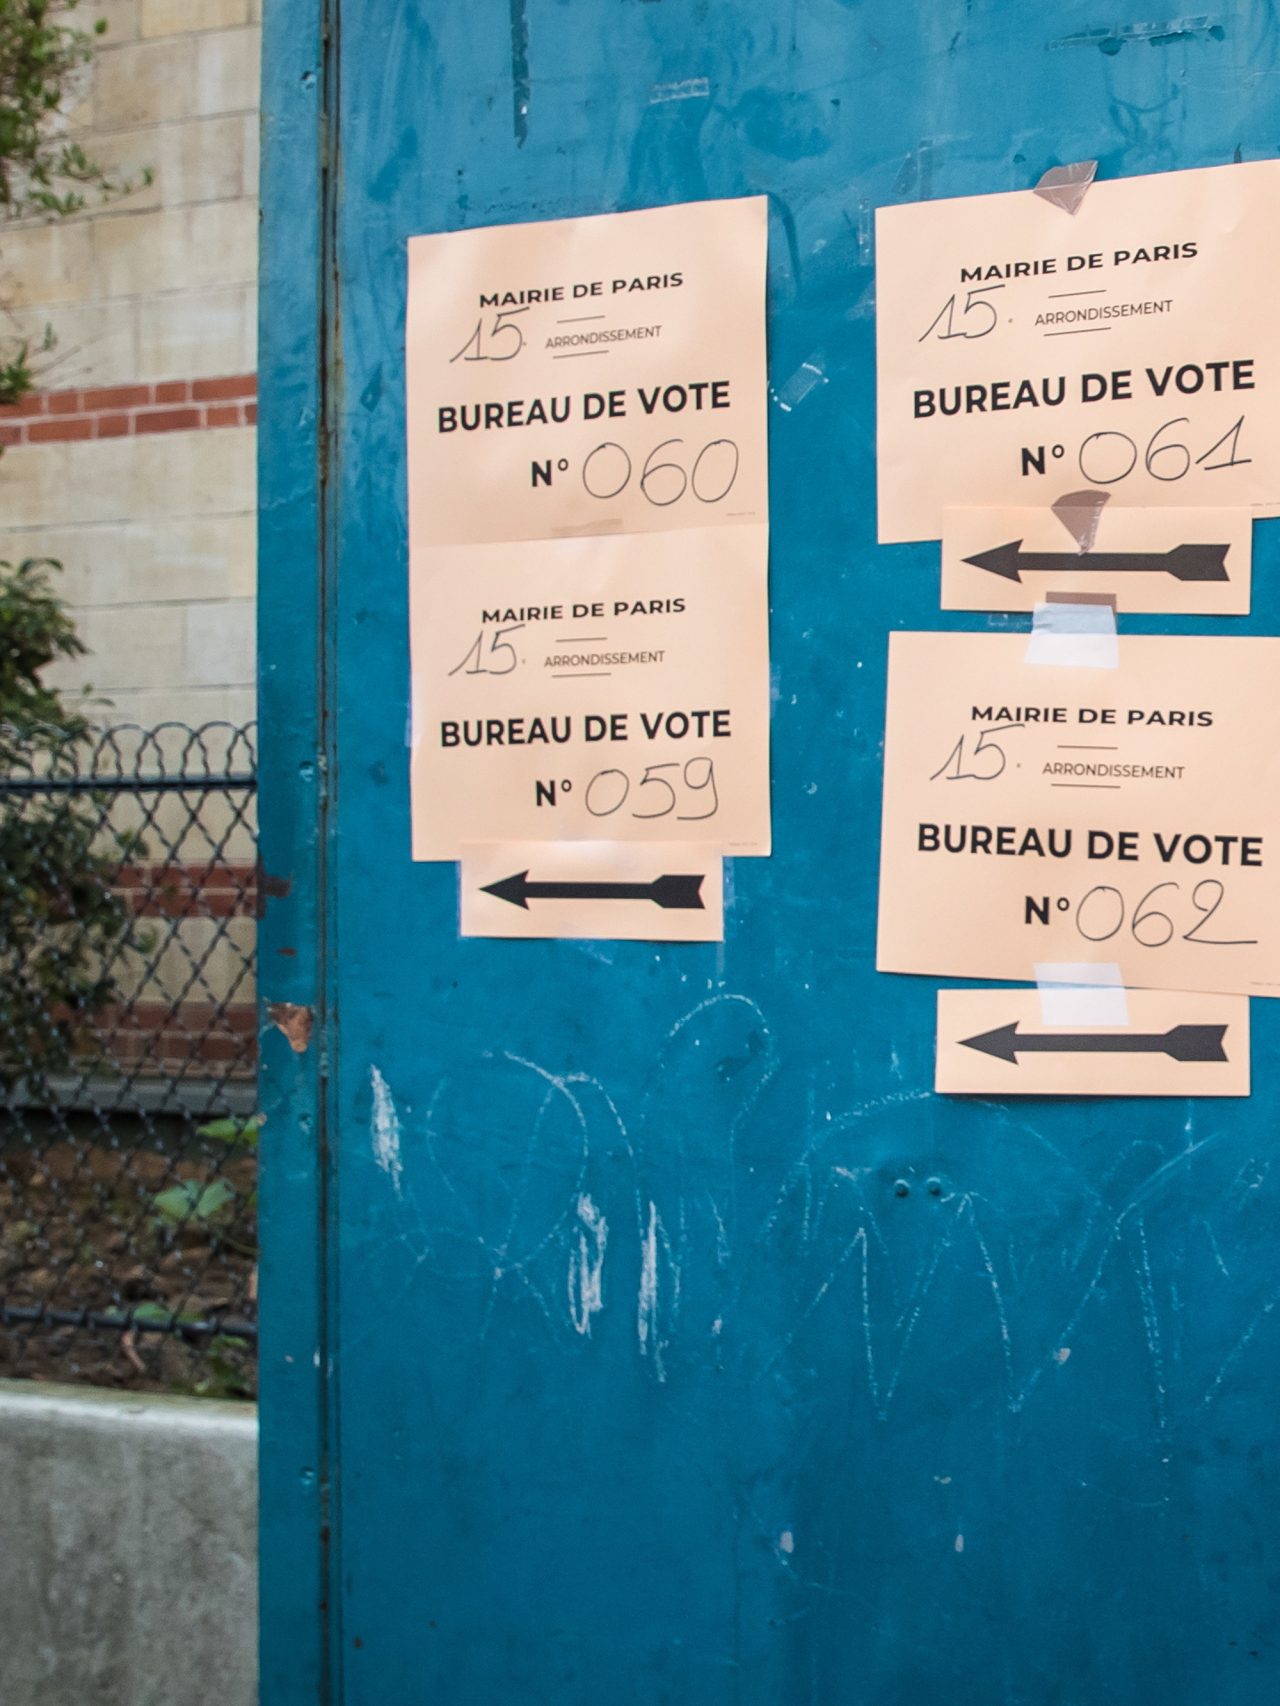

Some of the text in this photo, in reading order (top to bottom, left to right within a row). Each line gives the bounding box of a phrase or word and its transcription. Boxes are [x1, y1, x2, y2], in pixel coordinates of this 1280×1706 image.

[960, 242, 1199, 283] MAIRIE DE PARIS
[479, 272, 683, 308] MAIRIE DE PARIS
[1035, 300, 1173, 325] ARRONDISSEMENT
[545, 325, 662, 349] ARRONDISSEMENT
[438, 380, 730, 433] BUREAU DE VOTE
[913, 360, 1255, 418] BUREAU DE VOTE
[1020, 415, 1252, 484] N° 061
[531, 439, 739, 506] N° 060
[482, 598, 686, 624] MAIRIE DE PARIS
[544, 651, 665, 668] ARRONDISSEMENT
[441, 710, 731, 747] BUREAU DE VOTE
[971, 706, 1214, 726] MAIRIE DE PARIS
[536, 757, 718, 819] N° 059
[1042, 762, 1185, 780] ARRONDISSEMENT
[918, 823, 1263, 867] BUREAU DE VOTE
[1025, 879, 1258, 947] N° 062
